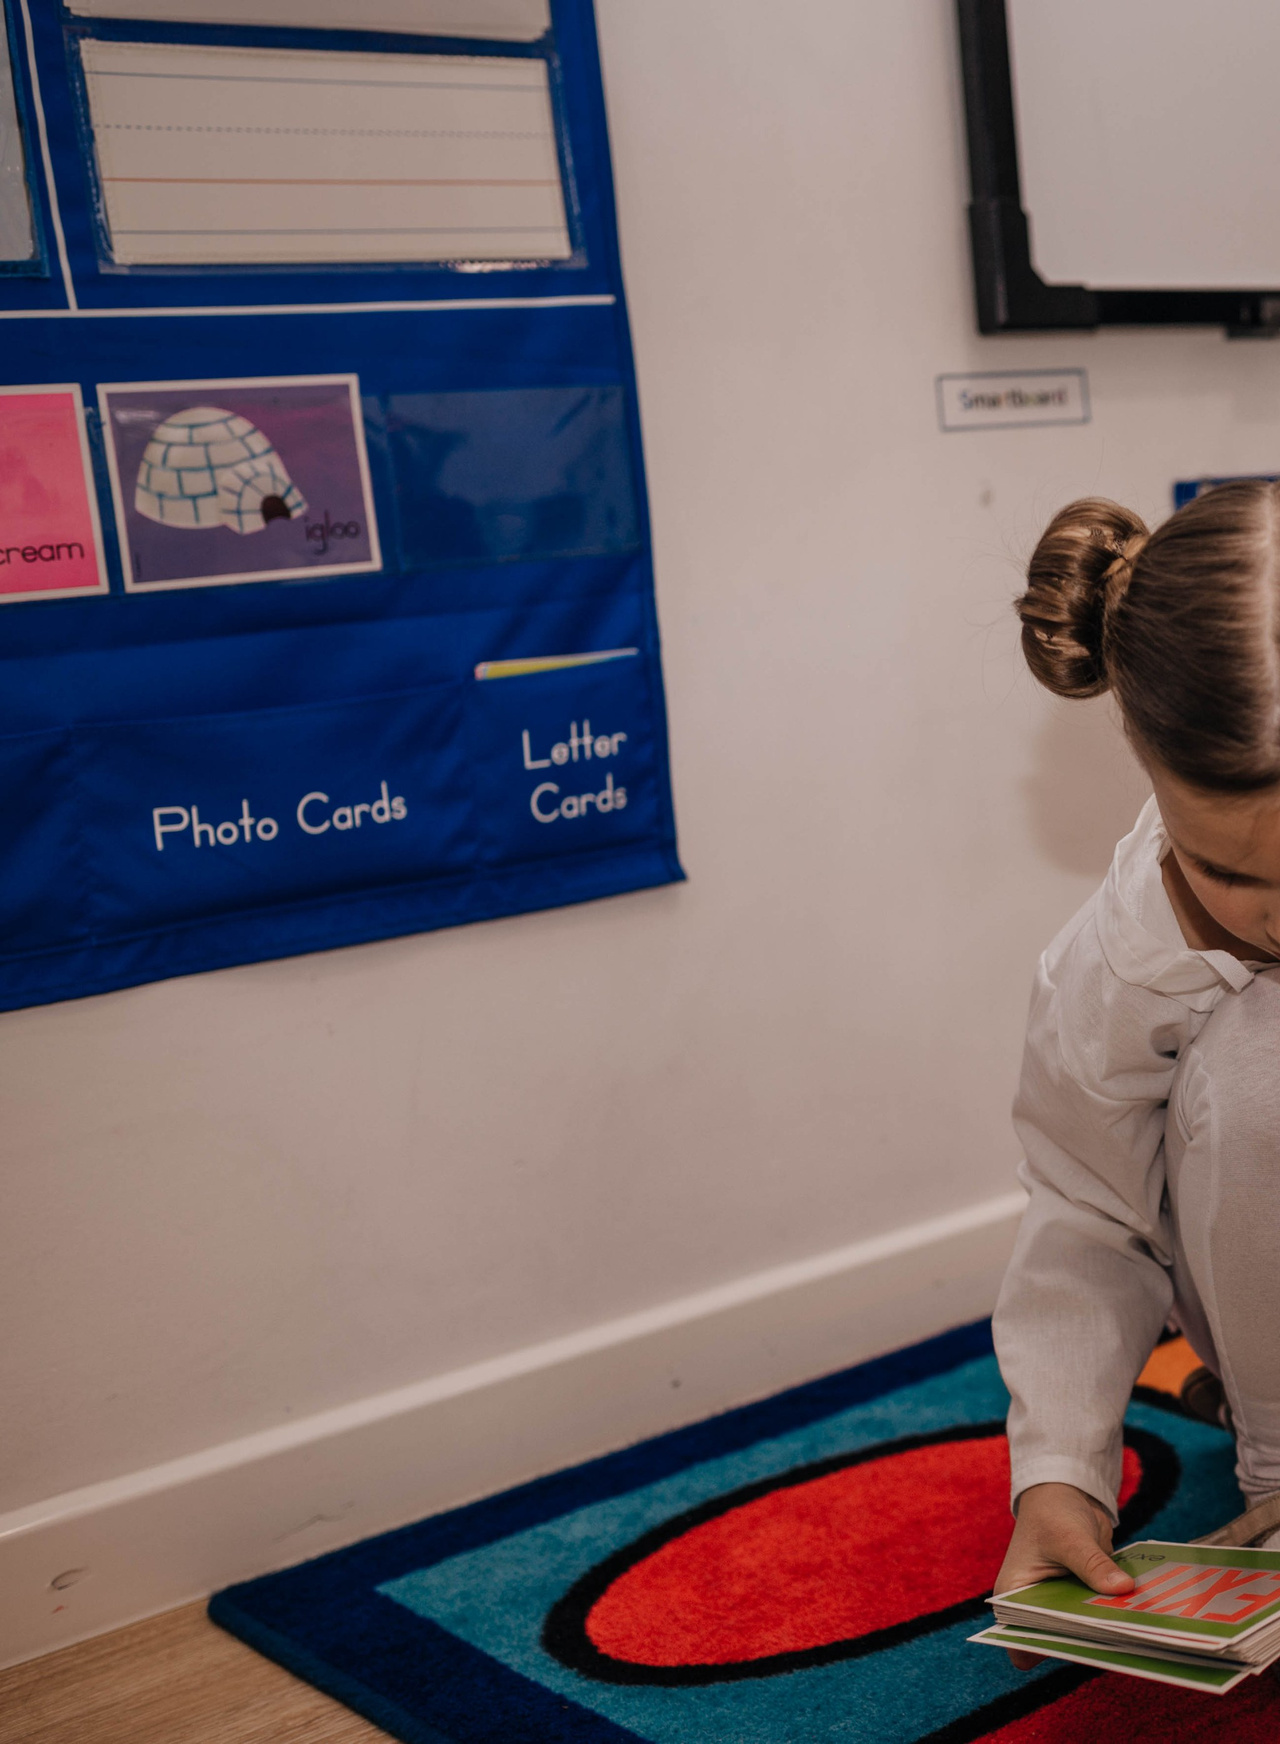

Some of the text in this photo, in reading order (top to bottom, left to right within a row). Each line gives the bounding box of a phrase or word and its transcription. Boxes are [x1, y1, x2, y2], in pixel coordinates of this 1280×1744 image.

[303, 509, 361, 556] igloo
[522, 719, 627, 770] Letter
[152, 780, 408, 851] Photo Cards
[530, 772, 627, 824] Cards
